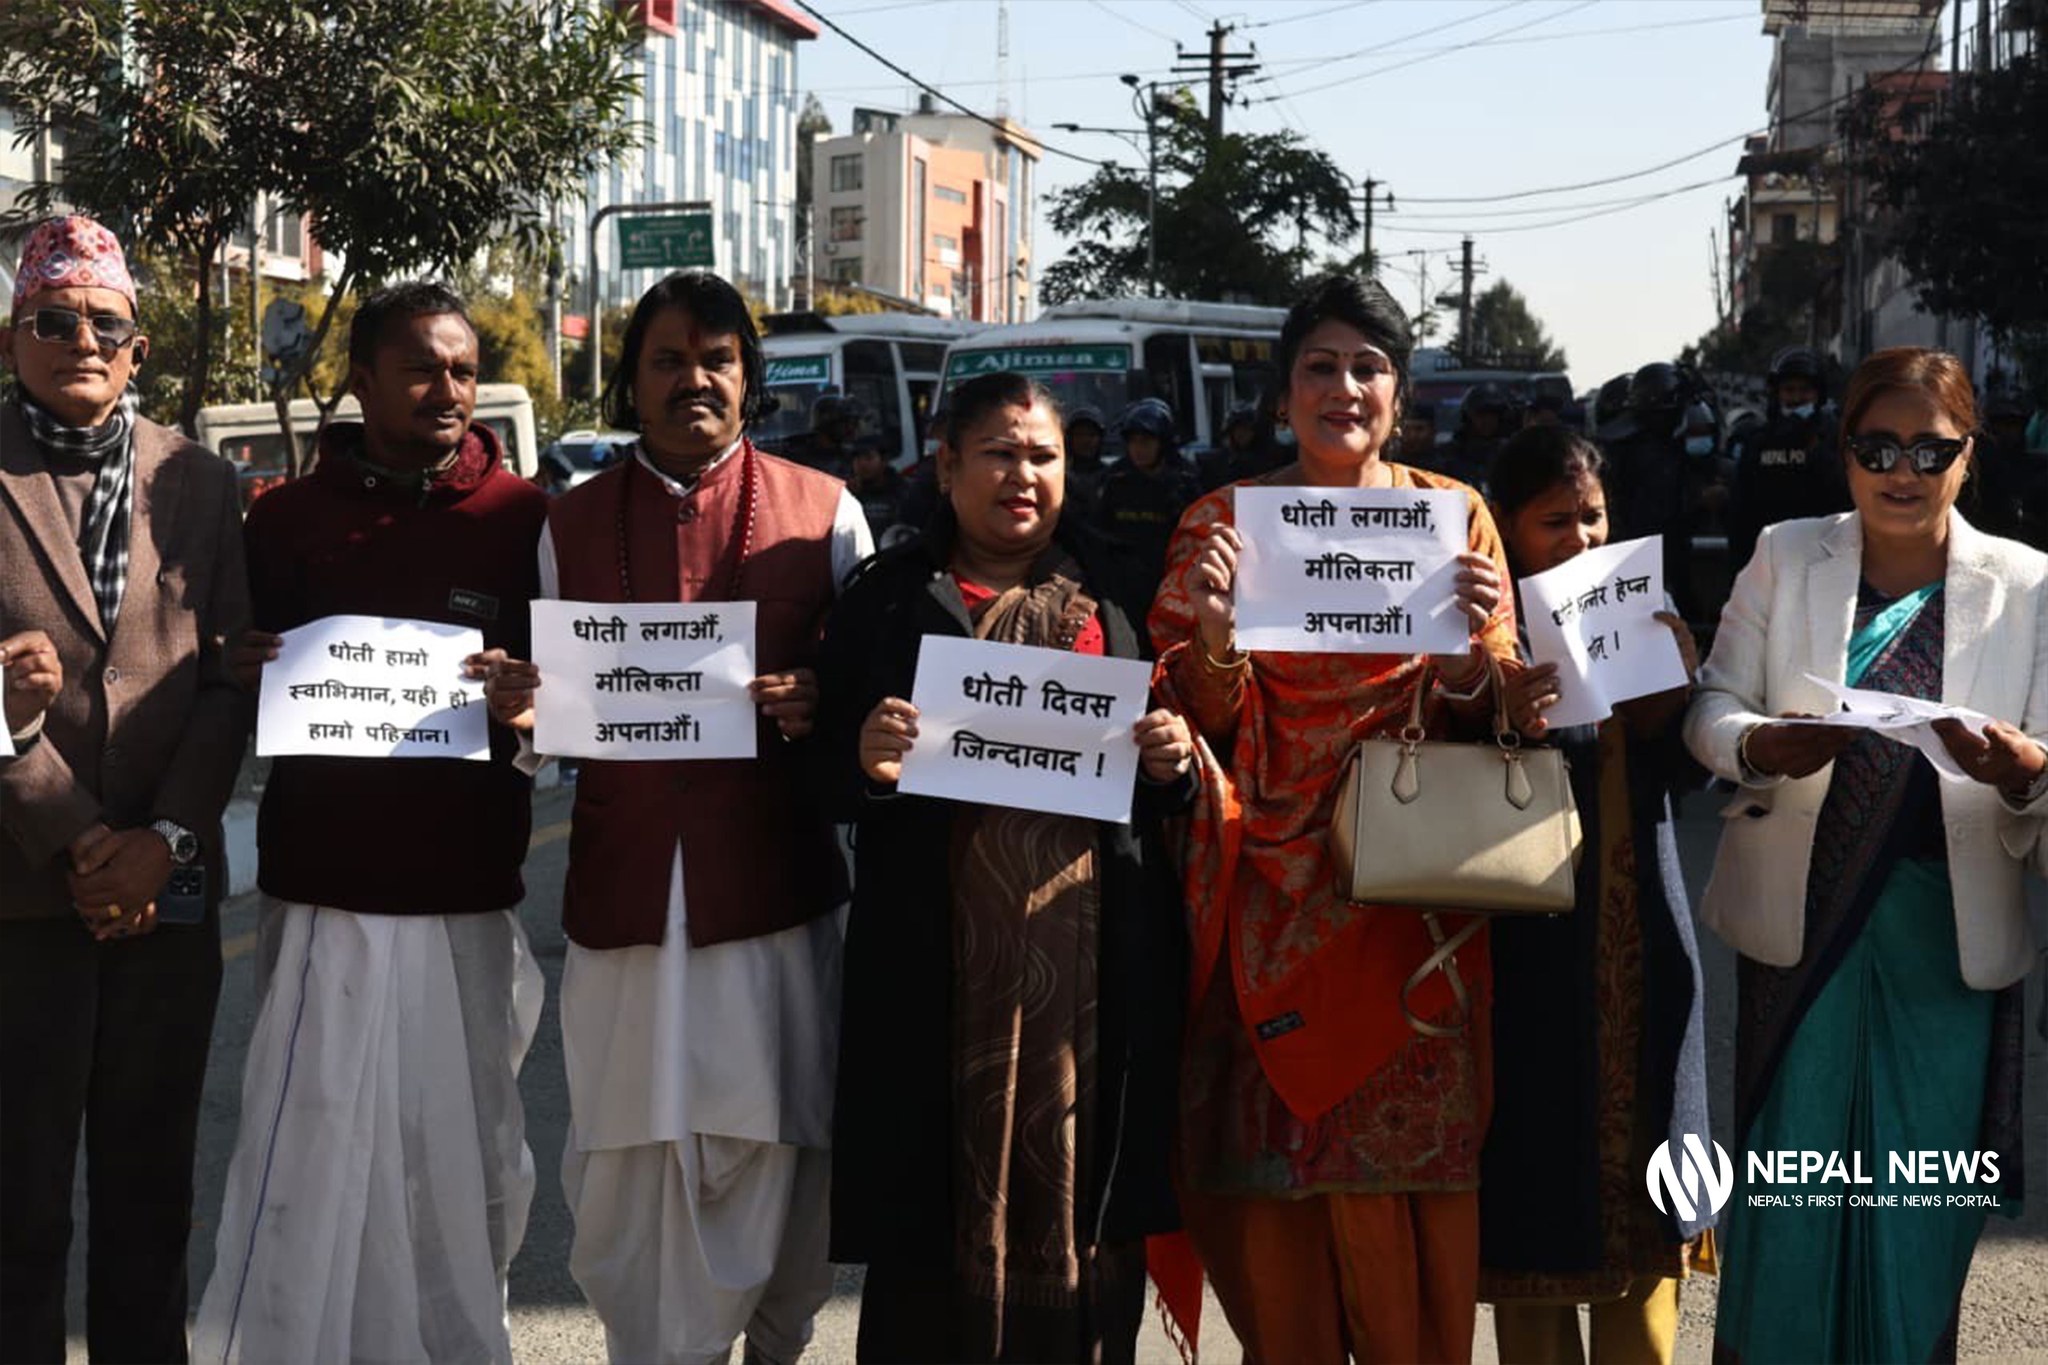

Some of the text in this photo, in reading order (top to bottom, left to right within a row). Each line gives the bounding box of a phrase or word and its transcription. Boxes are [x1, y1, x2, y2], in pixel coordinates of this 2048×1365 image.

[1281, 499, 1337, 528] धोती
[1305, 552, 1414, 581] मौलिकता
[573, 616, 627, 642] धोती
[328, 641, 374, 662] धोती
[288, 679, 468, 708] स्वाभिमान, यही हो
[595, 666, 703, 692] मौलिकता
[962, 672, 1116, 718] धोती दिवस
[952, 730, 1105, 777] जिन्दावाद !
